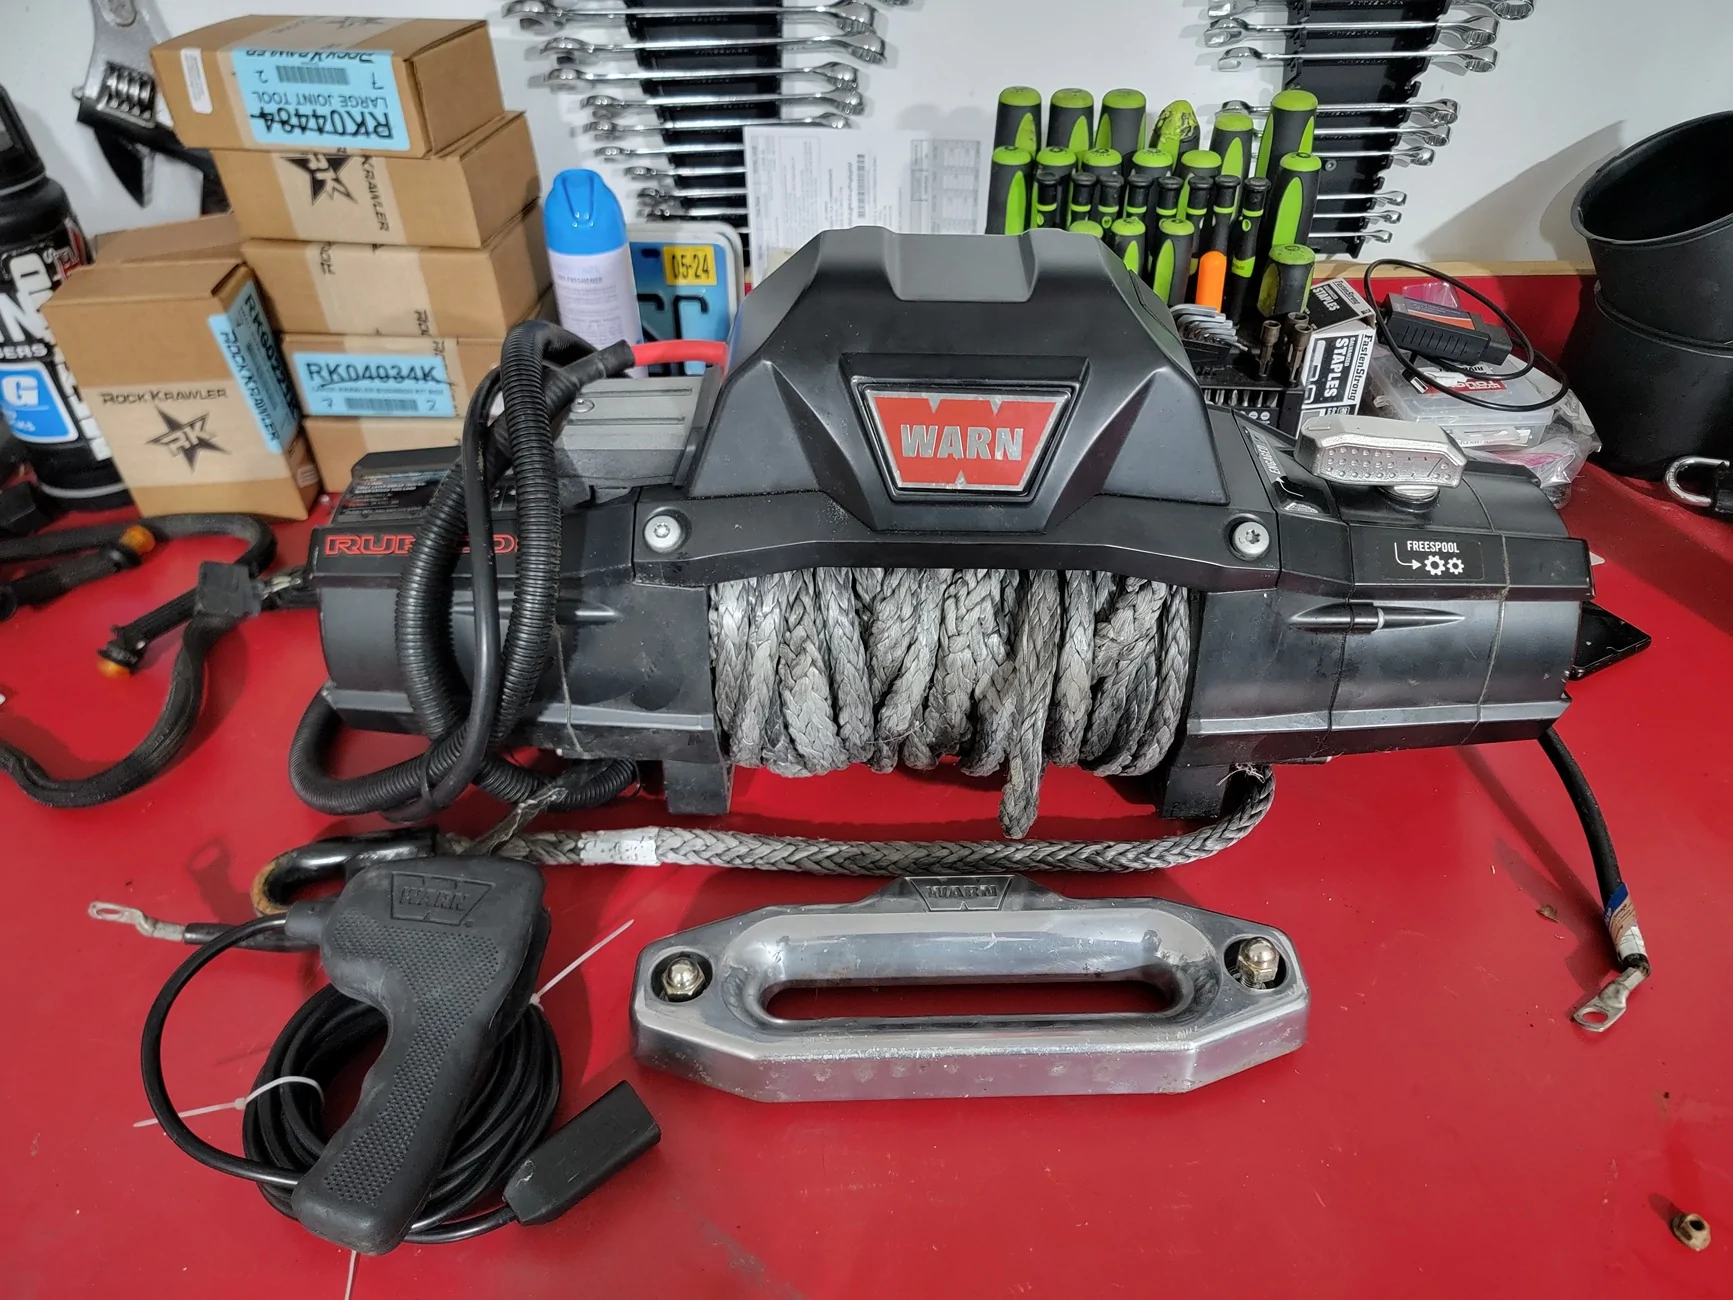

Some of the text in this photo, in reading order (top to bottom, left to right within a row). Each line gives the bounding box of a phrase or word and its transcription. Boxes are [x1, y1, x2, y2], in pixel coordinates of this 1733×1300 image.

[252, 90, 389, 109] LARGE JOINT TOOL
[258, 106, 394, 139] RK04484
[671, 253, 710, 280] 05-24
[1313, 288, 1340, 311] STAPLES
[306, 362, 438, 385] RK04034K
[1324, 338, 1349, 398] STAPLES
[1347, 334, 1373, 401] FastenStrong
[900, 424, 1024, 461] WARN
[1407, 540, 1460, 553] FREESPOOL
[399, 886, 471, 911] WARN
[925, 884, 998, 899] WARN
